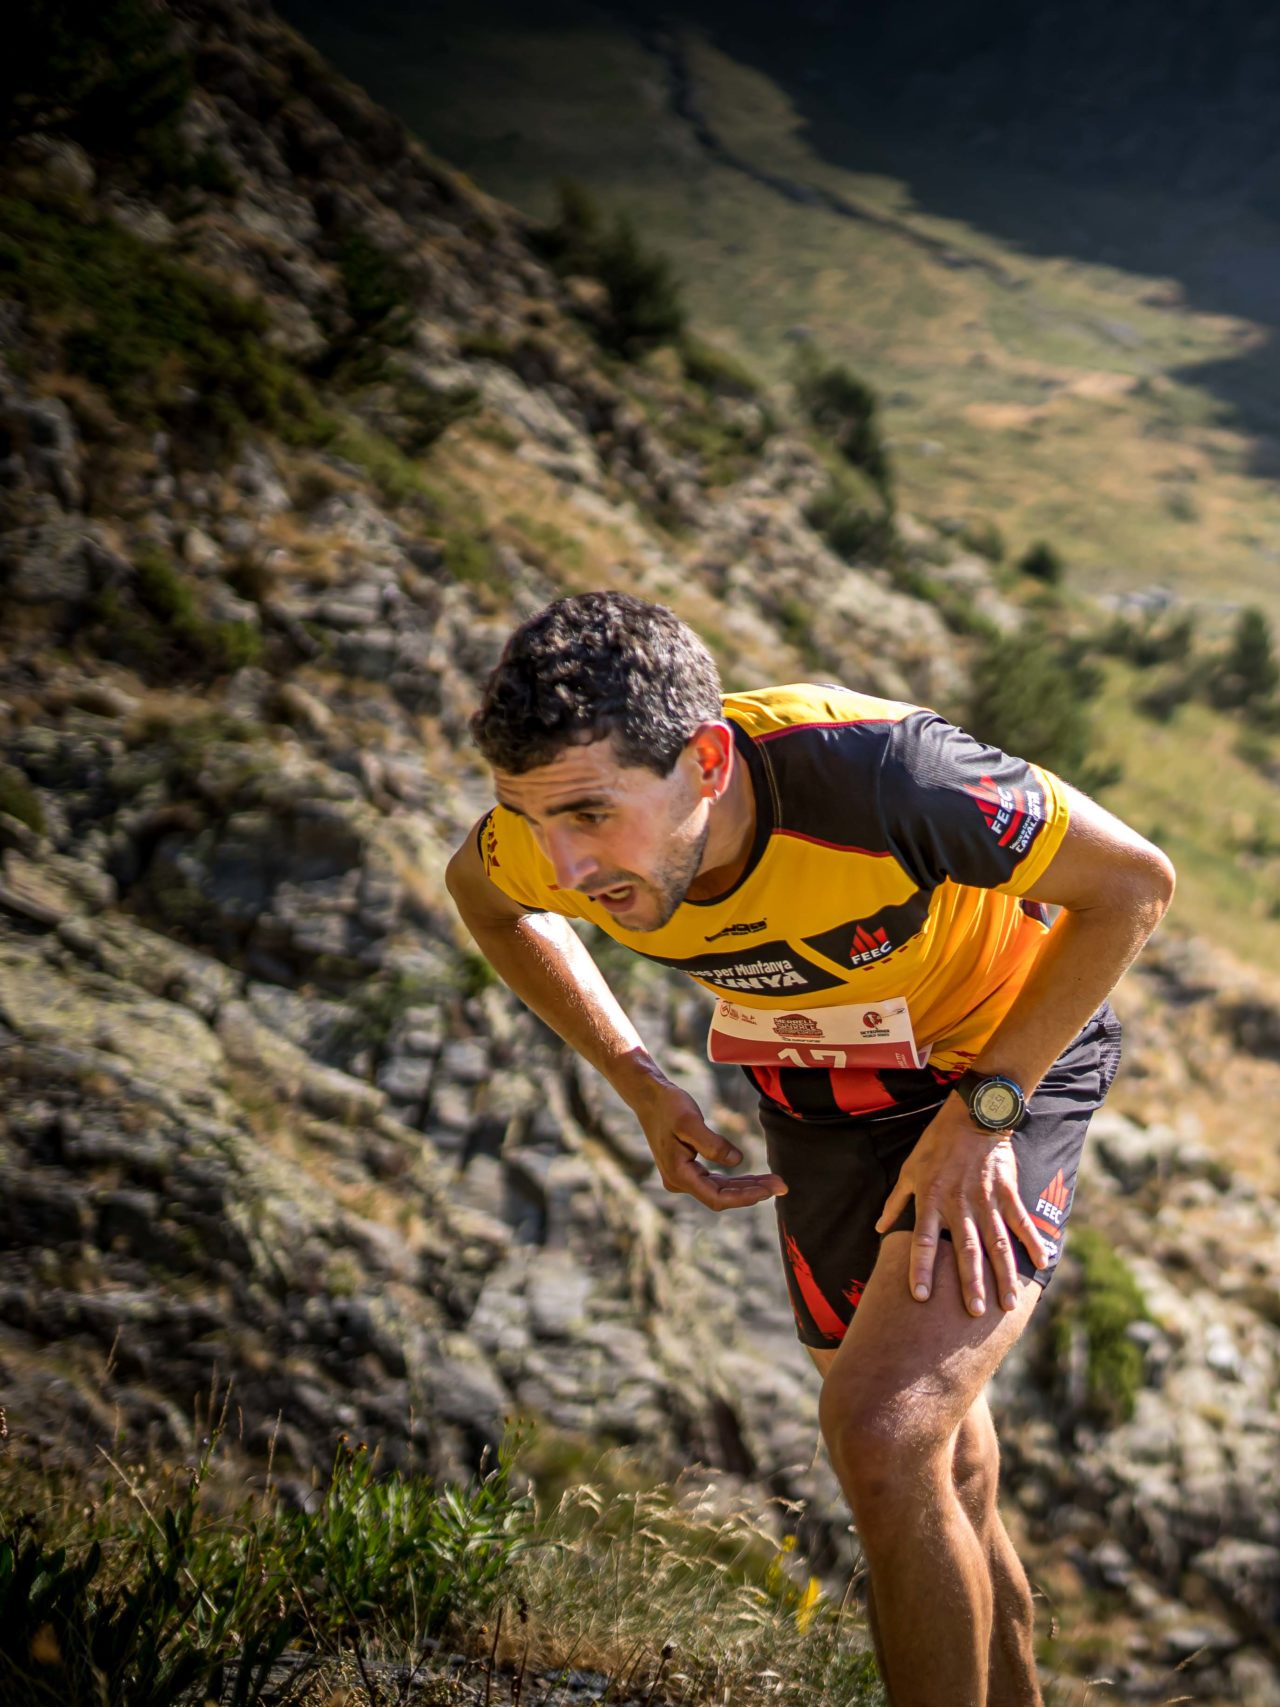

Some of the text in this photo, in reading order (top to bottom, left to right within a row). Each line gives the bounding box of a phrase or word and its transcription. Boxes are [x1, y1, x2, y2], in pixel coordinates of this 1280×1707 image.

[990, 786, 1015, 835] FEEC
[850, 940, 892, 965] FEEC
[714, 968, 734, 979] per
[734, 959, 793, 977] Muntanya
[1035, 1198, 1063, 1224] FEEC
